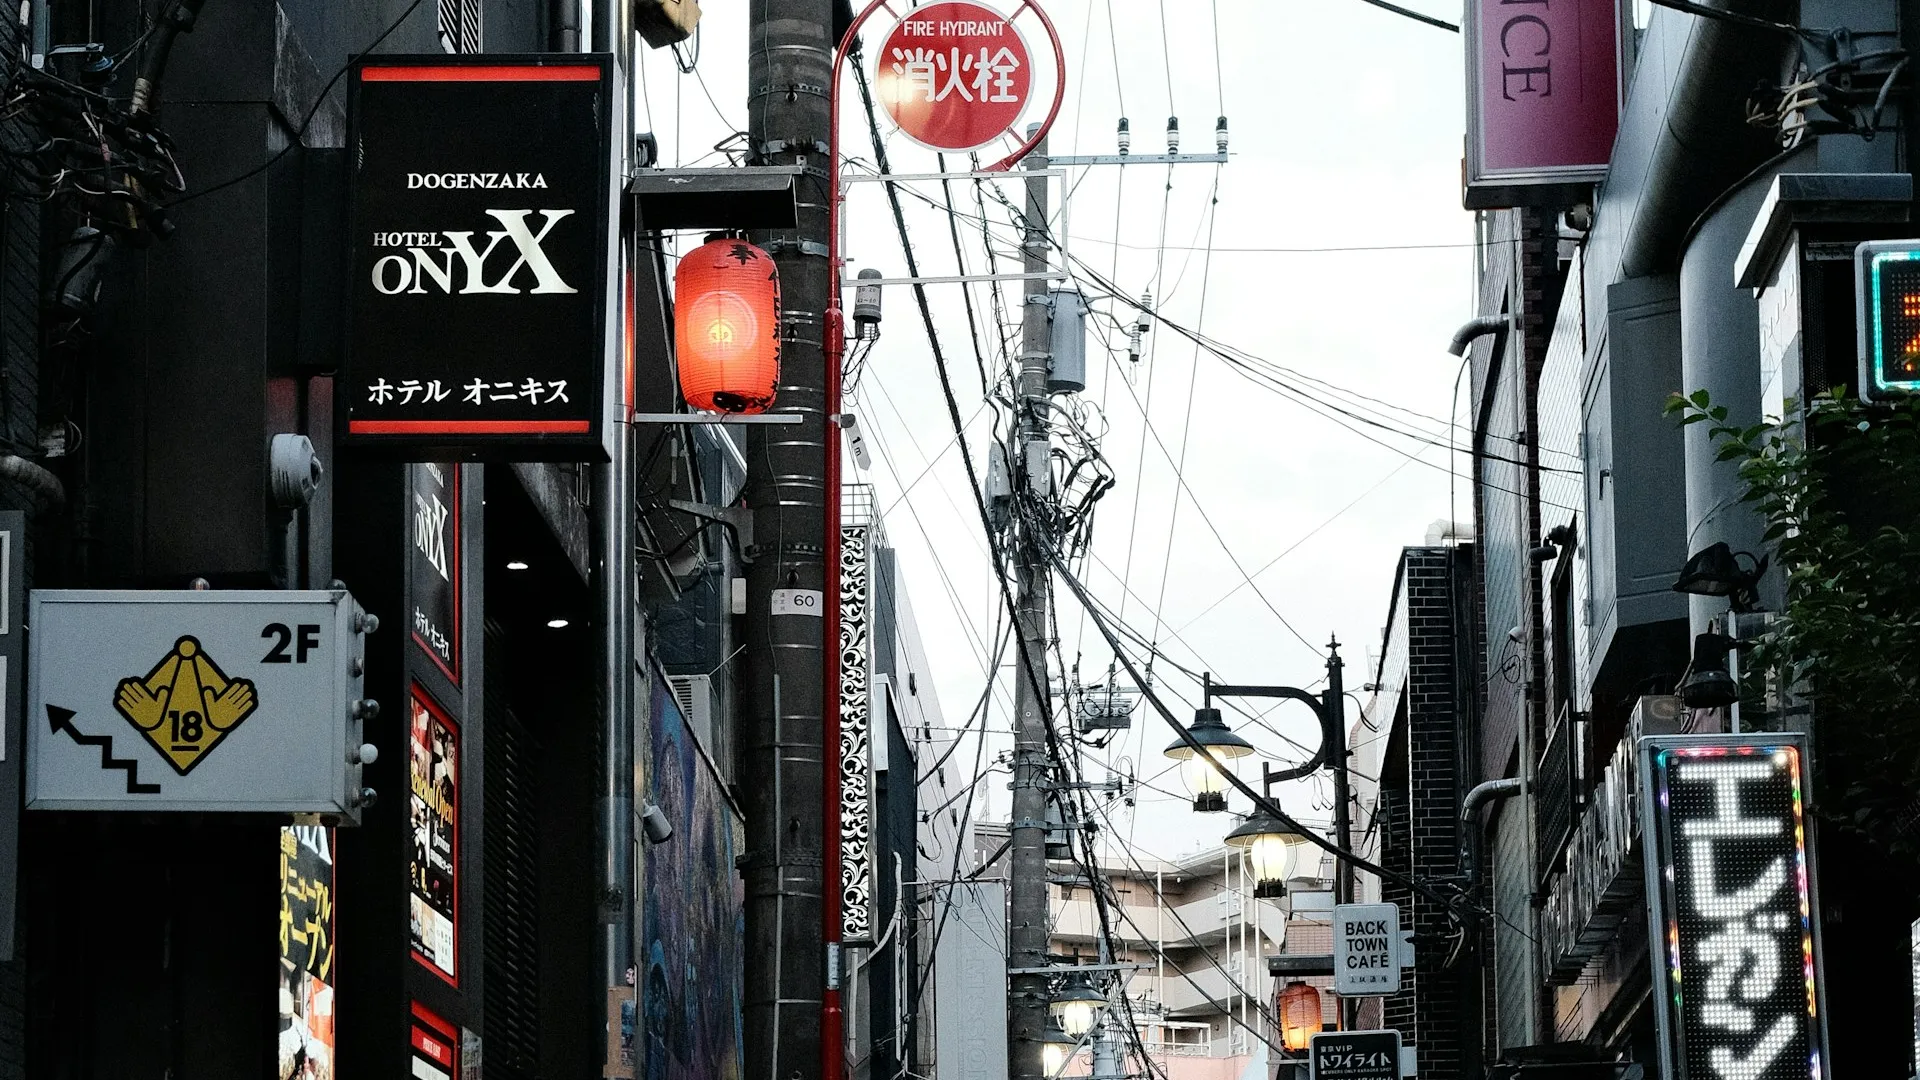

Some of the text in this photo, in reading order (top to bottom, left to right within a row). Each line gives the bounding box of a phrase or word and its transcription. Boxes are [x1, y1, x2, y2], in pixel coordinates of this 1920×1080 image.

[903, 20, 1006, 37] FIRE HYDRANT
[1500, 0, 1552, 102] CE
[892, 47, 1020, 103] 消火栓
[407, 173, 548, 189] DOGENZAKA
[373, 232, 442, 247] HOTEL
[371, 209, 579, 295] ONYX
[368, 377, 570, 406] ホテル オニキス
[414, 493, 449, 582] ONYX
[793, 594, 815, 607] 60
[260, 622, 321, 664] 2F
[168, 710, 204, 743] 18
[1345, 920, 1387, 936] BACK
[1346, 938, 1388, 952] TOWN
[1347, 952, 1389, 969] CAFÉ
[1320, 1052, 1392, 1070] トワイライト
